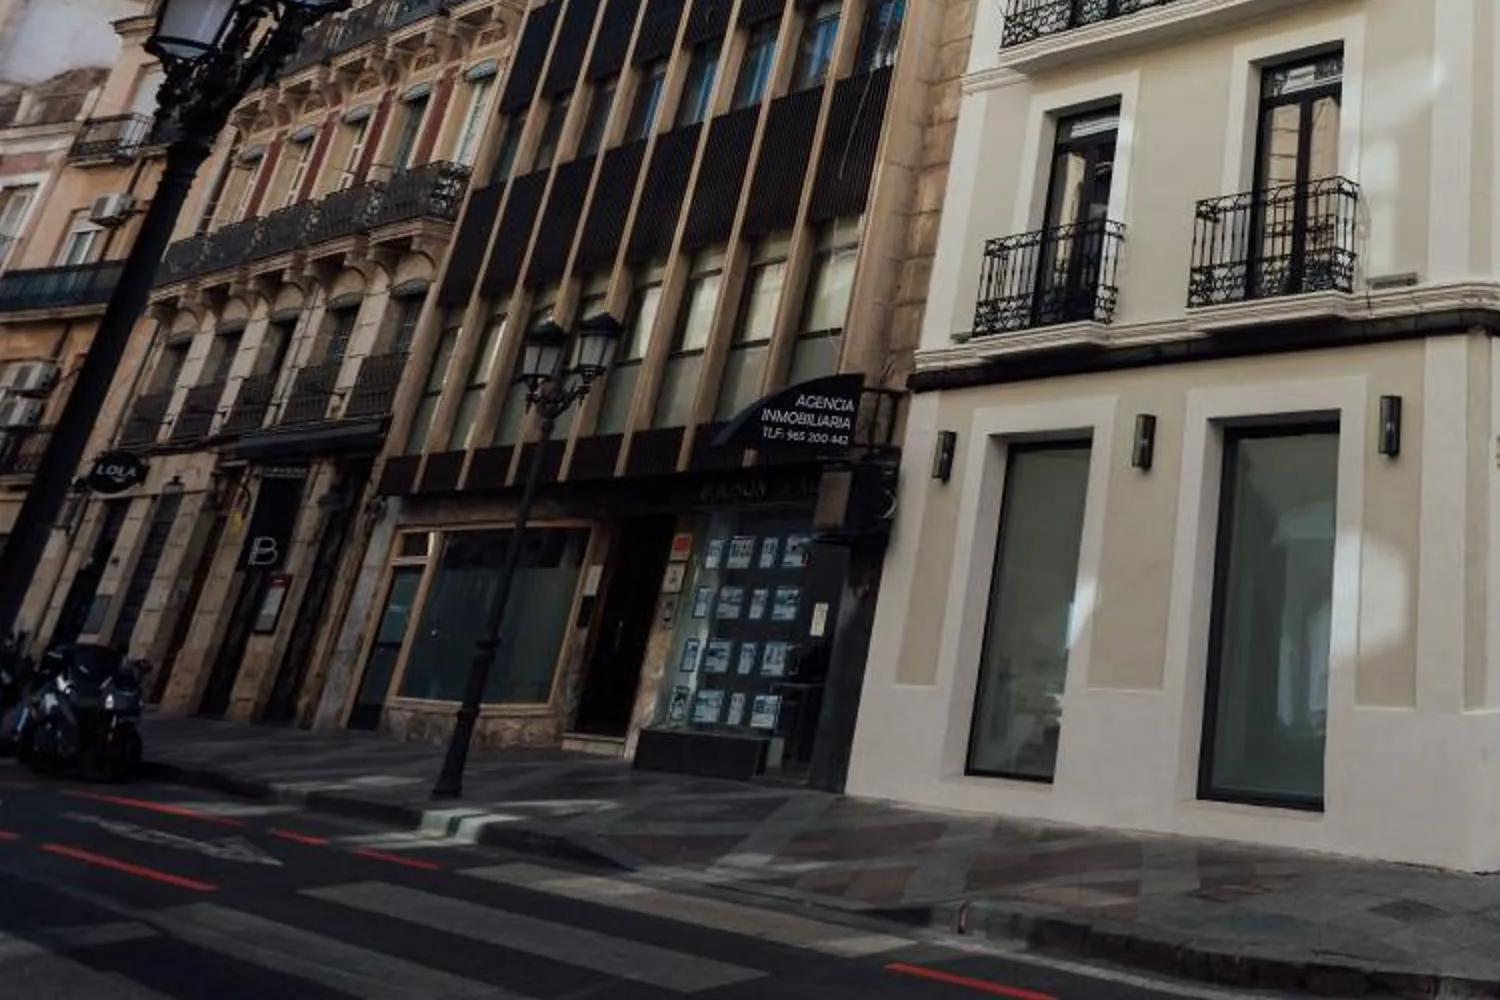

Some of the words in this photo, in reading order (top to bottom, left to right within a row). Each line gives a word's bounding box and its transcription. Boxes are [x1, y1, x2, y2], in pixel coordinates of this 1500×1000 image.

[795, 394, 854, 412] AGENCIA
[761, 408, 851, 430] INMOBILIARIA
[808, 432, 829, 443] 200
[96, 463, 137, 477] LOLA
